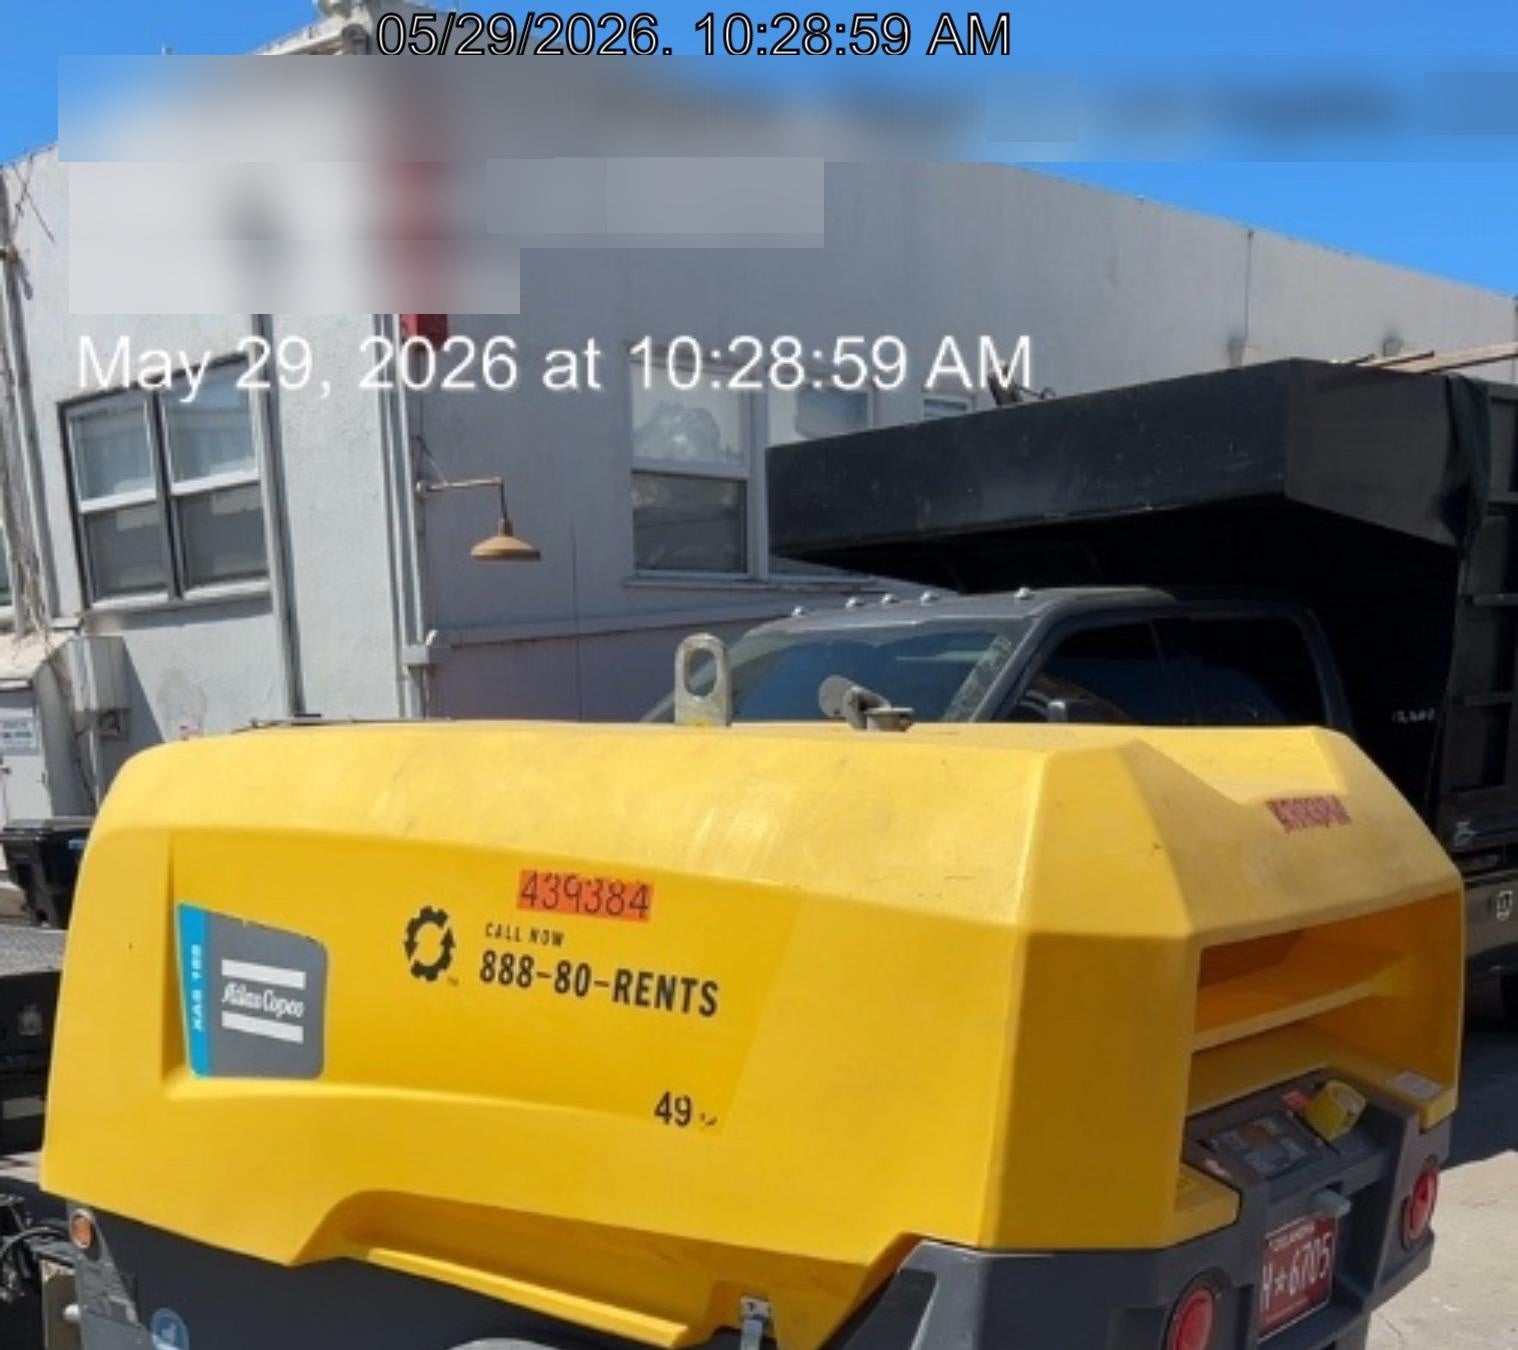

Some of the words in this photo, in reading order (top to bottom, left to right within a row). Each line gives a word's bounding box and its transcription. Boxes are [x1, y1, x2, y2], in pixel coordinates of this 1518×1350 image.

[518, 869, 651, 918] 439384
[485, 922, 522, 943] CALL
[528, 928, 564, 947] NOW
[222, 981, 262, 1009] Atlas
[262, 989, 304, 1019] Copco
[480, 949, 719, 1018] 888-80-RENTS
[653, 1090, 693, 1127] 49
